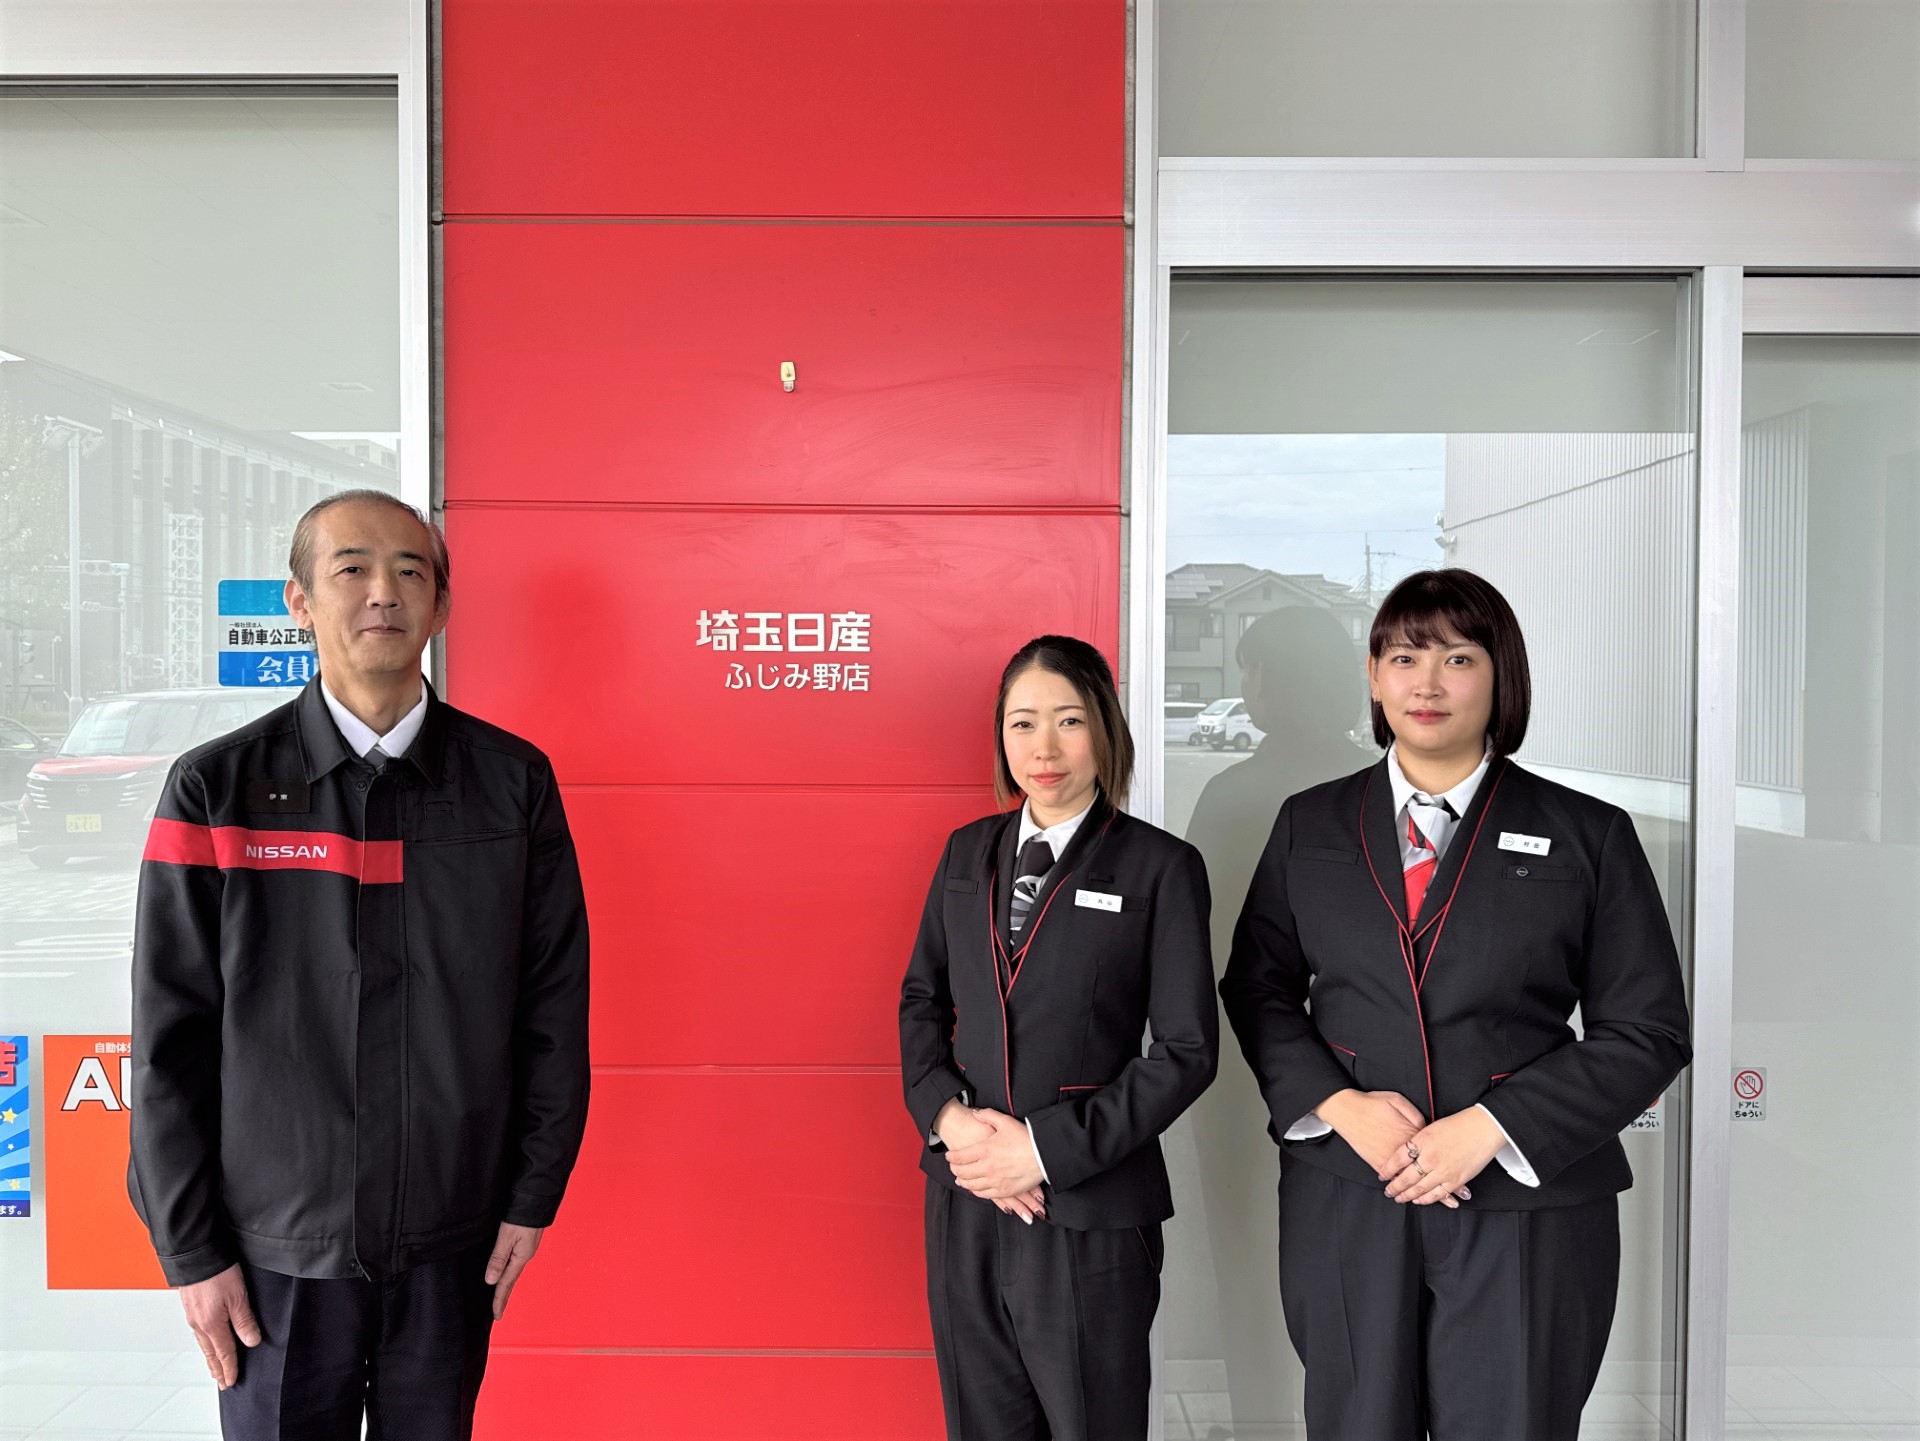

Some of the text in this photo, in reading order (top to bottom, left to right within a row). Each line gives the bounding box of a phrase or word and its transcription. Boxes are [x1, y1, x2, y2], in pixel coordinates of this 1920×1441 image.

[696, 610, 871, 652] 埼玉日産
[256, 655, 319, 683] 会員
[725, 663, 870, 691] ふじみ野店
[246, 845, 327, 858] NISSAN
[1735, 1110, 1762, 1118] ちゅうい
